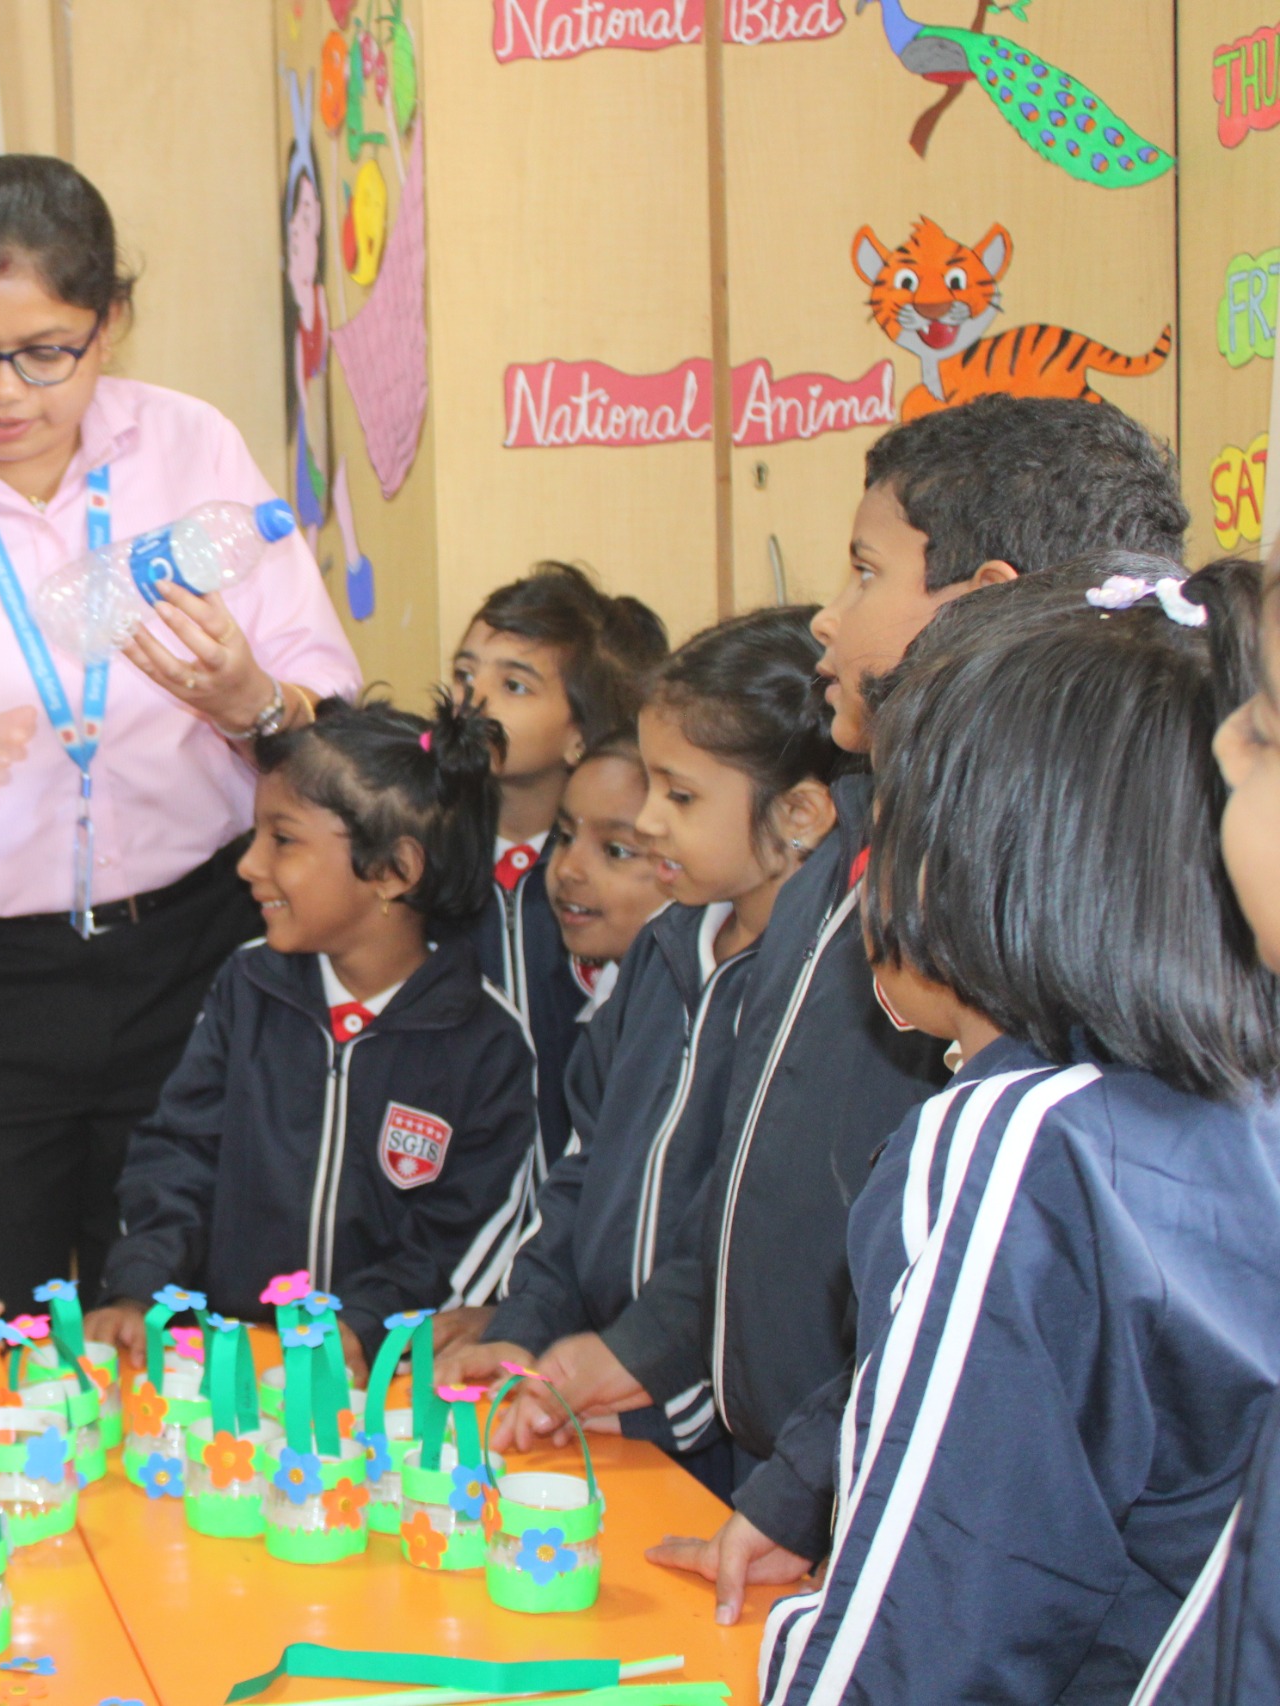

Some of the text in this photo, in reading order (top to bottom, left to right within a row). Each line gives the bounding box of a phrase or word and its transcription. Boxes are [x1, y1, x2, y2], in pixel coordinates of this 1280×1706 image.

[496, 0, 843, 59] National Bird
[1213, 34, 1280, 117] THU
[503, 361, 896, 447] National Animal
[389, 1130, 439, 1162] SGIS
